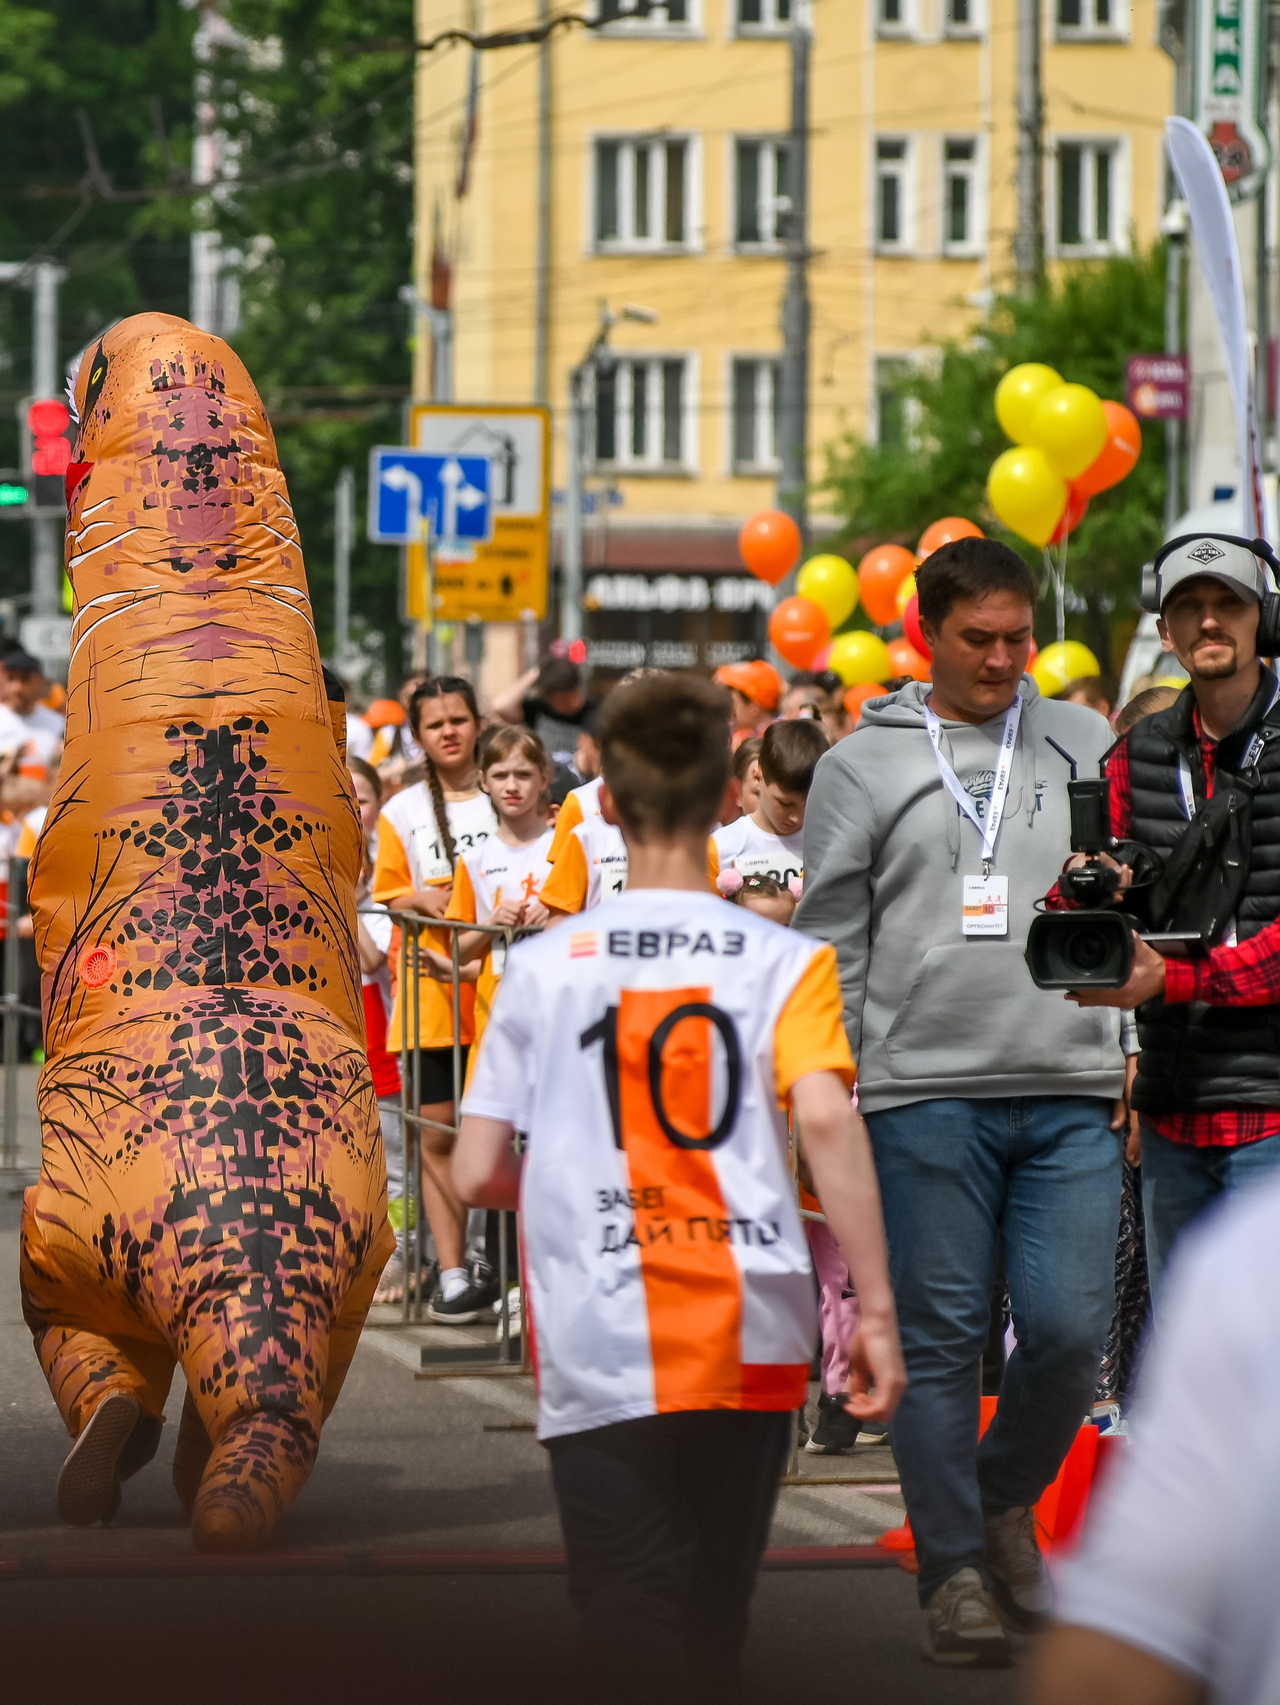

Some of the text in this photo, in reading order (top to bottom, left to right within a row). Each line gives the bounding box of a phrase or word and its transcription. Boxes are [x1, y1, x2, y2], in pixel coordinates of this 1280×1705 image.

[1005, 728, 1014, 749] ЕВРАЗ
[997, 770, 1007, 790] ЕВРАЗ
[607, 930, 746, 958] ЕВРАЗ
[579, 1002, 742, 1152] 10
[600, 1216, 674, 1256] ДАЙ
